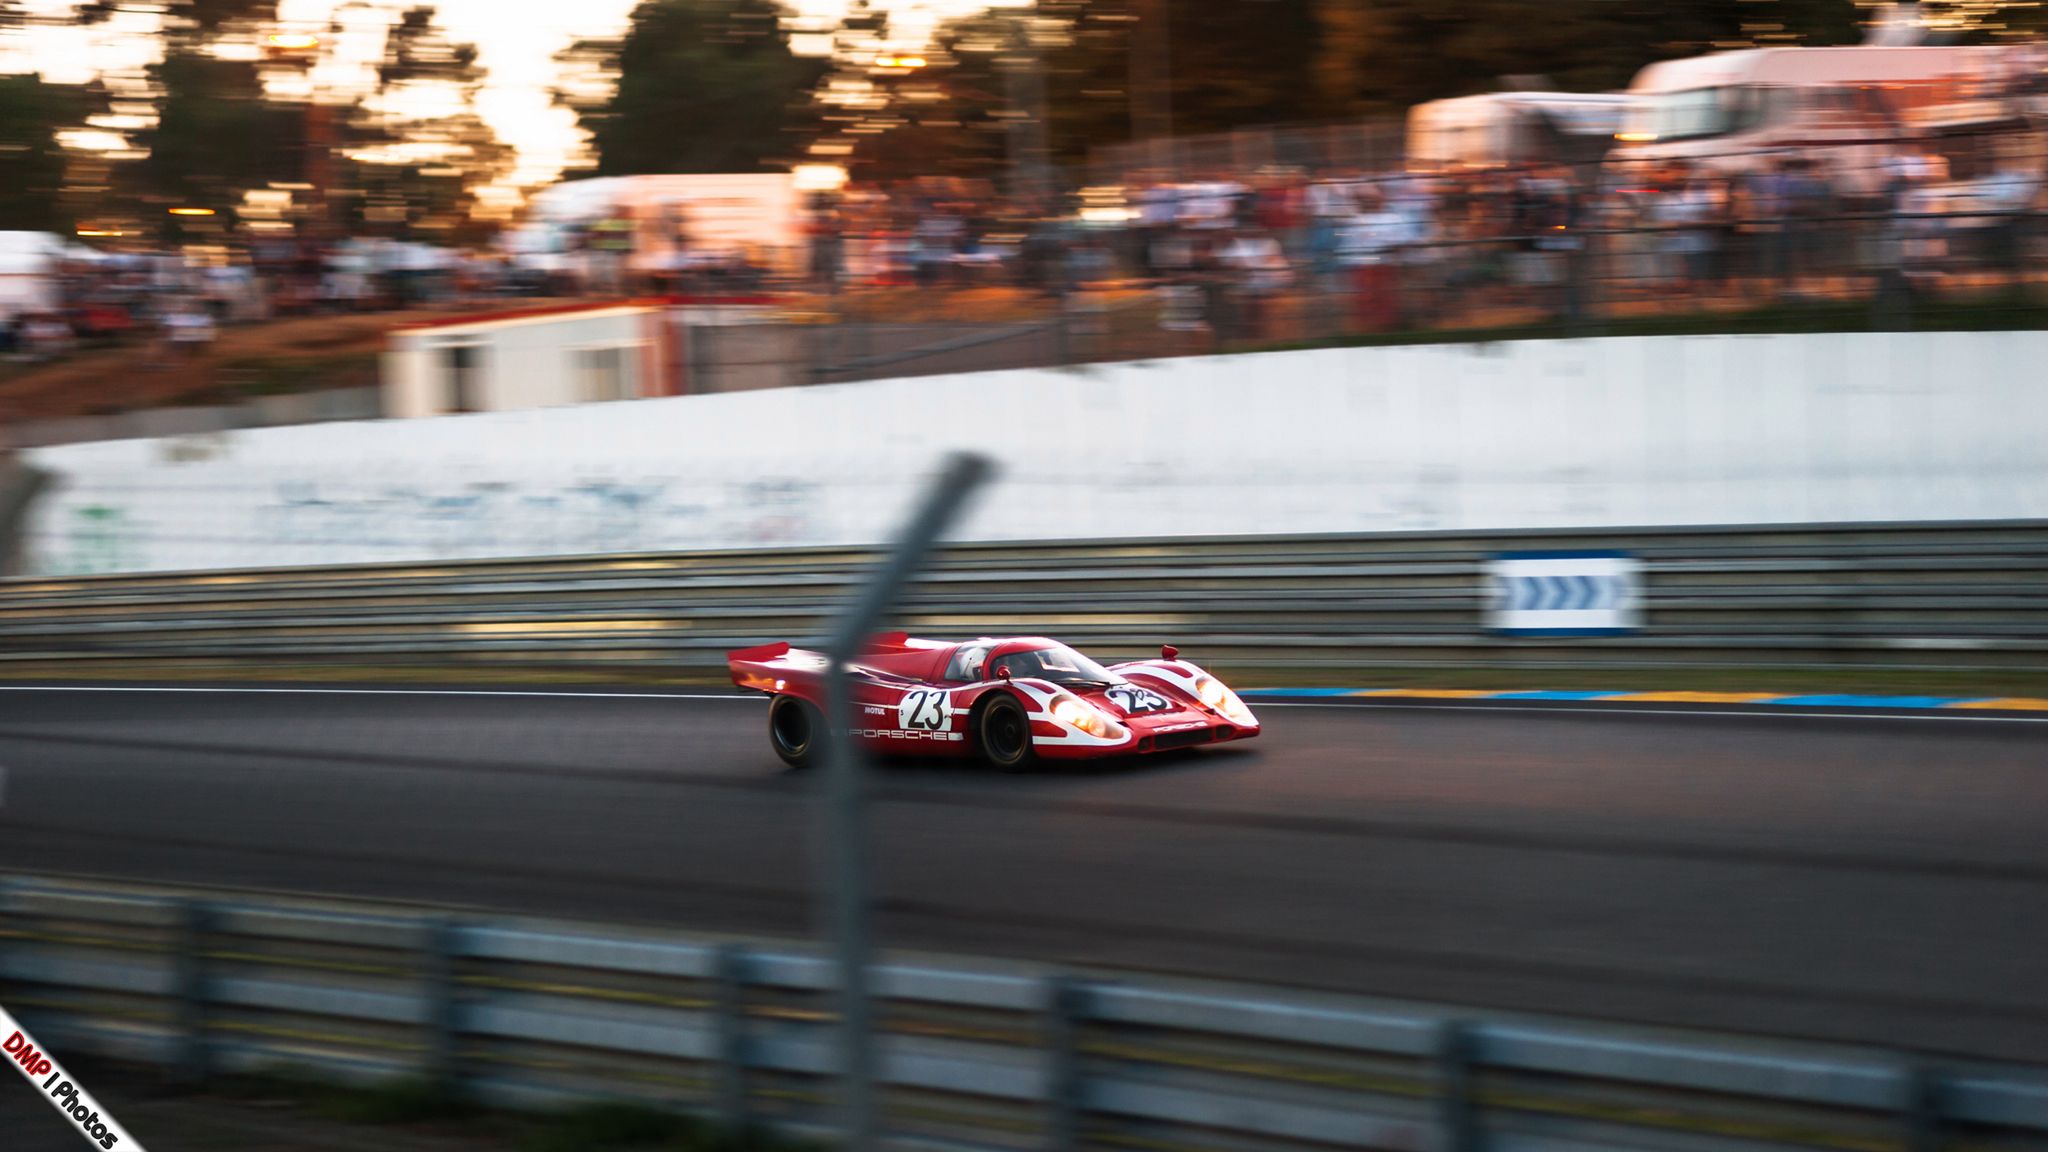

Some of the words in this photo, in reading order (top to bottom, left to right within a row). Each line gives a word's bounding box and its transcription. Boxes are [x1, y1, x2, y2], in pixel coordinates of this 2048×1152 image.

[908, 690, 947, 730] 23
[1108, 690, 1167, 713] 23
[864, 707, 885, 715] MOTUL
[848, 729, 947, 740] PORSCHE
